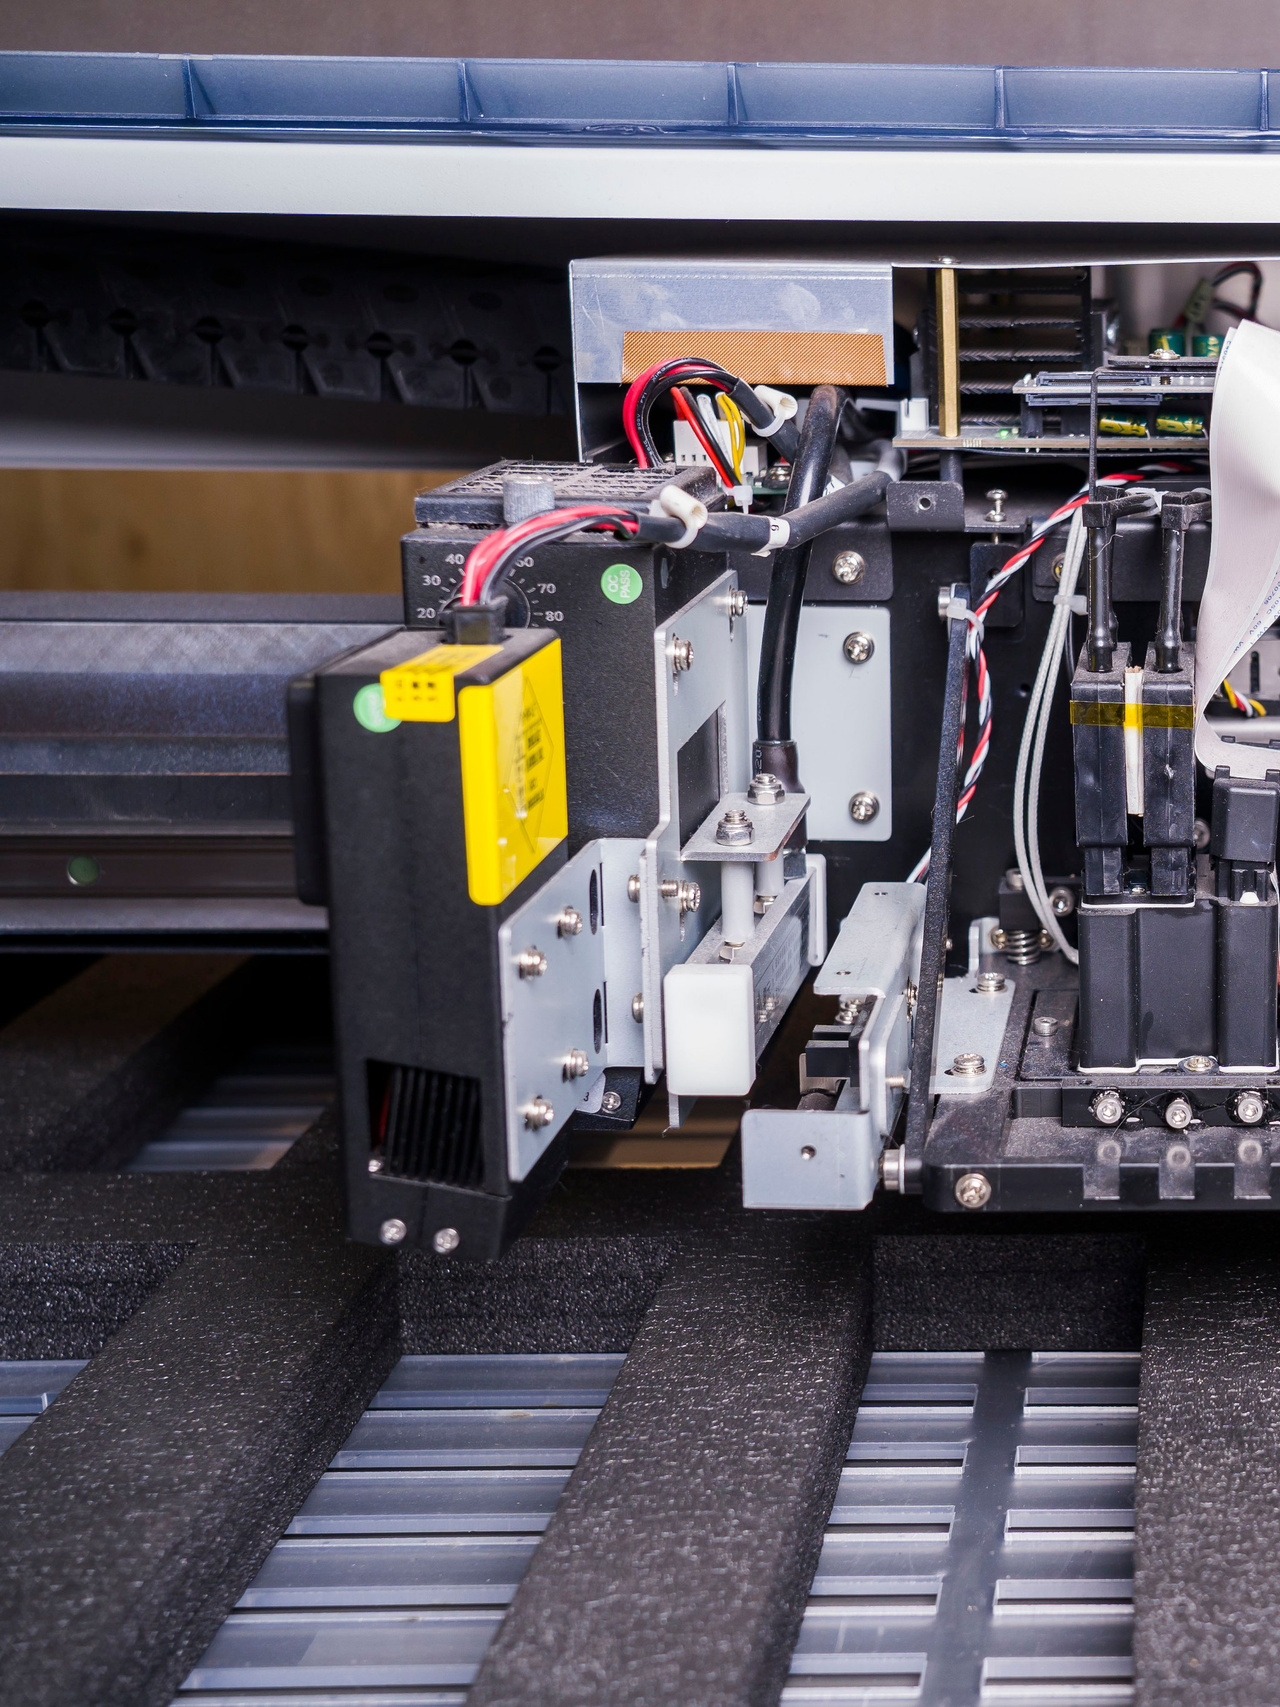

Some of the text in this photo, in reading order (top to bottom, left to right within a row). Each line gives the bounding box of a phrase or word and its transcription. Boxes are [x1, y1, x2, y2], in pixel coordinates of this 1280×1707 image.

[445, 553, 465, 565] 40
[422, 575, 442, 586] 30
[607, 574, 619, 592] QC
[620, 570, 631, 598] PASS
[537, 583, 557, 594] 70
[417, 608, 437, 619] 20
[545, 611, 564, 622] 80
